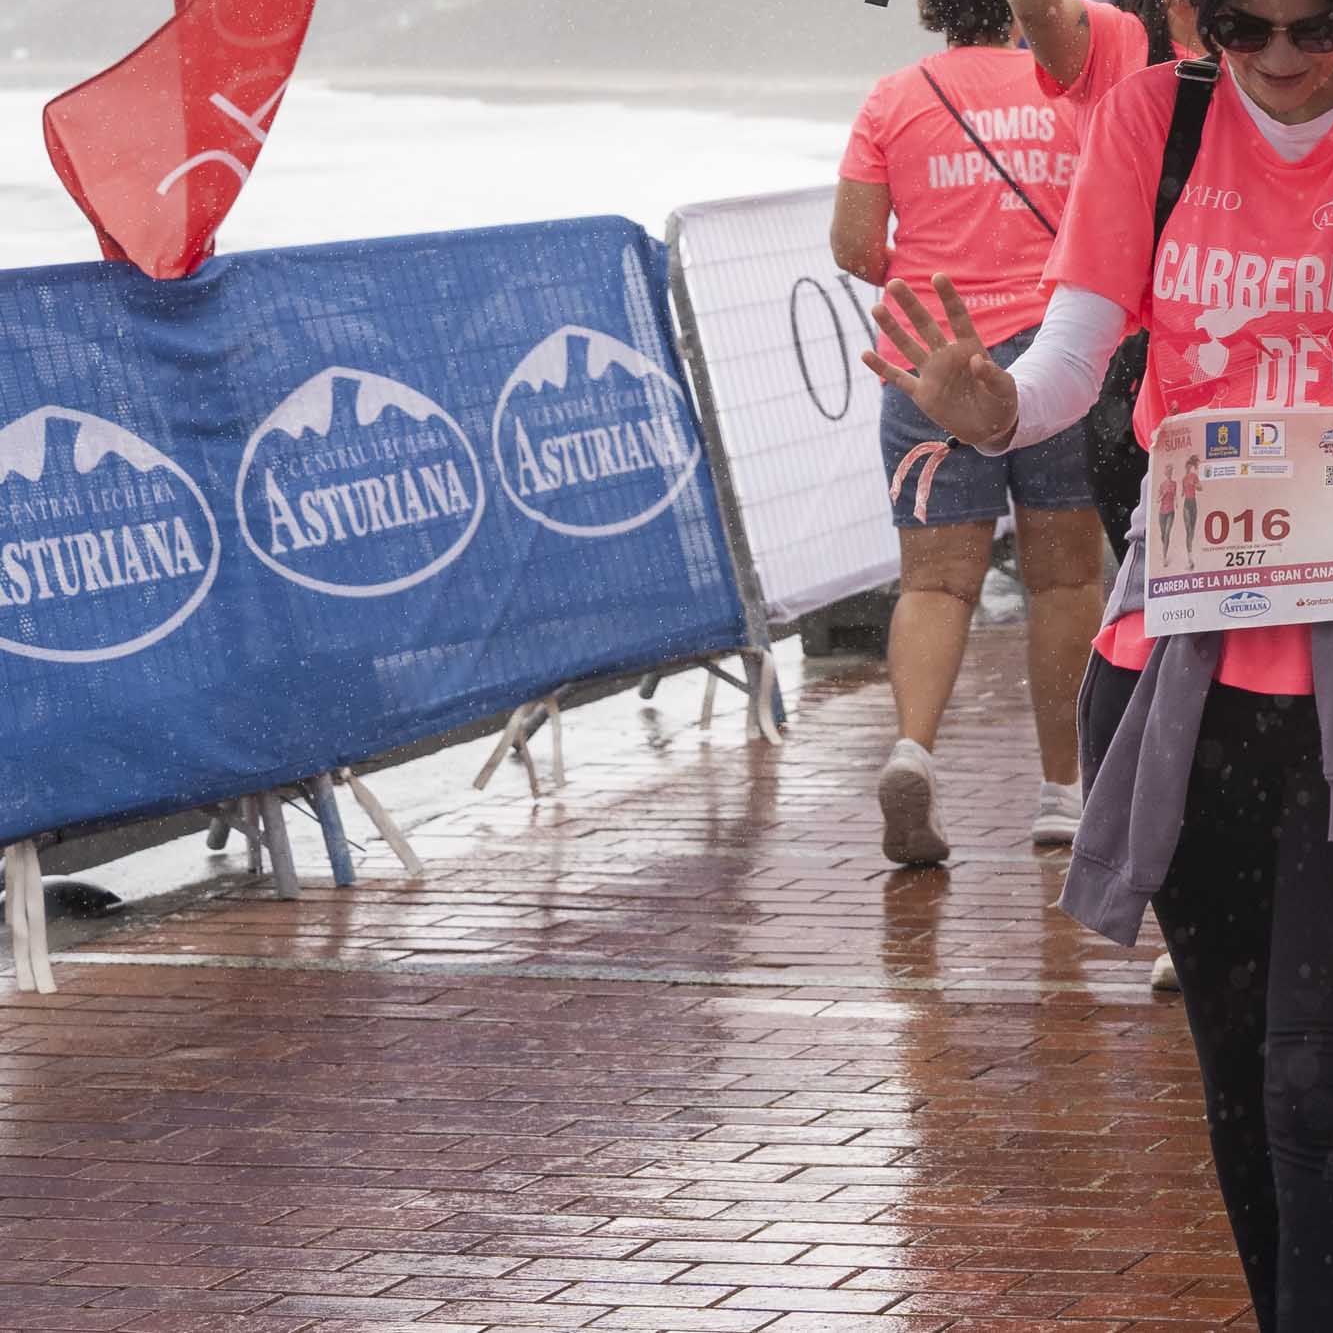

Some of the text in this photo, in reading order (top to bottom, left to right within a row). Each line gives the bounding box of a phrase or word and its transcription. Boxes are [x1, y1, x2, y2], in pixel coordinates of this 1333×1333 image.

[1252, 332, 1333, 409] DE
[87, 481, 177, 515] LECHERA
[265, 460, 474, 555] ASTURIANA
[1203, 508, 1291, 546] 016
[1225, 549, 1267, 567] 2577
[1152, 578, 1191, 594] CARRERA
[1191, 577, 1205, 592] DE
[1207, 575, 1221, 588] LA
[1223, 572, 1261, 586] MUJER
[1270, 569, 1302, 583] GRAN
[1162, 608, 1195, 622] OYSHO
[1223, 602, 1268, 613] ASTURIANA
